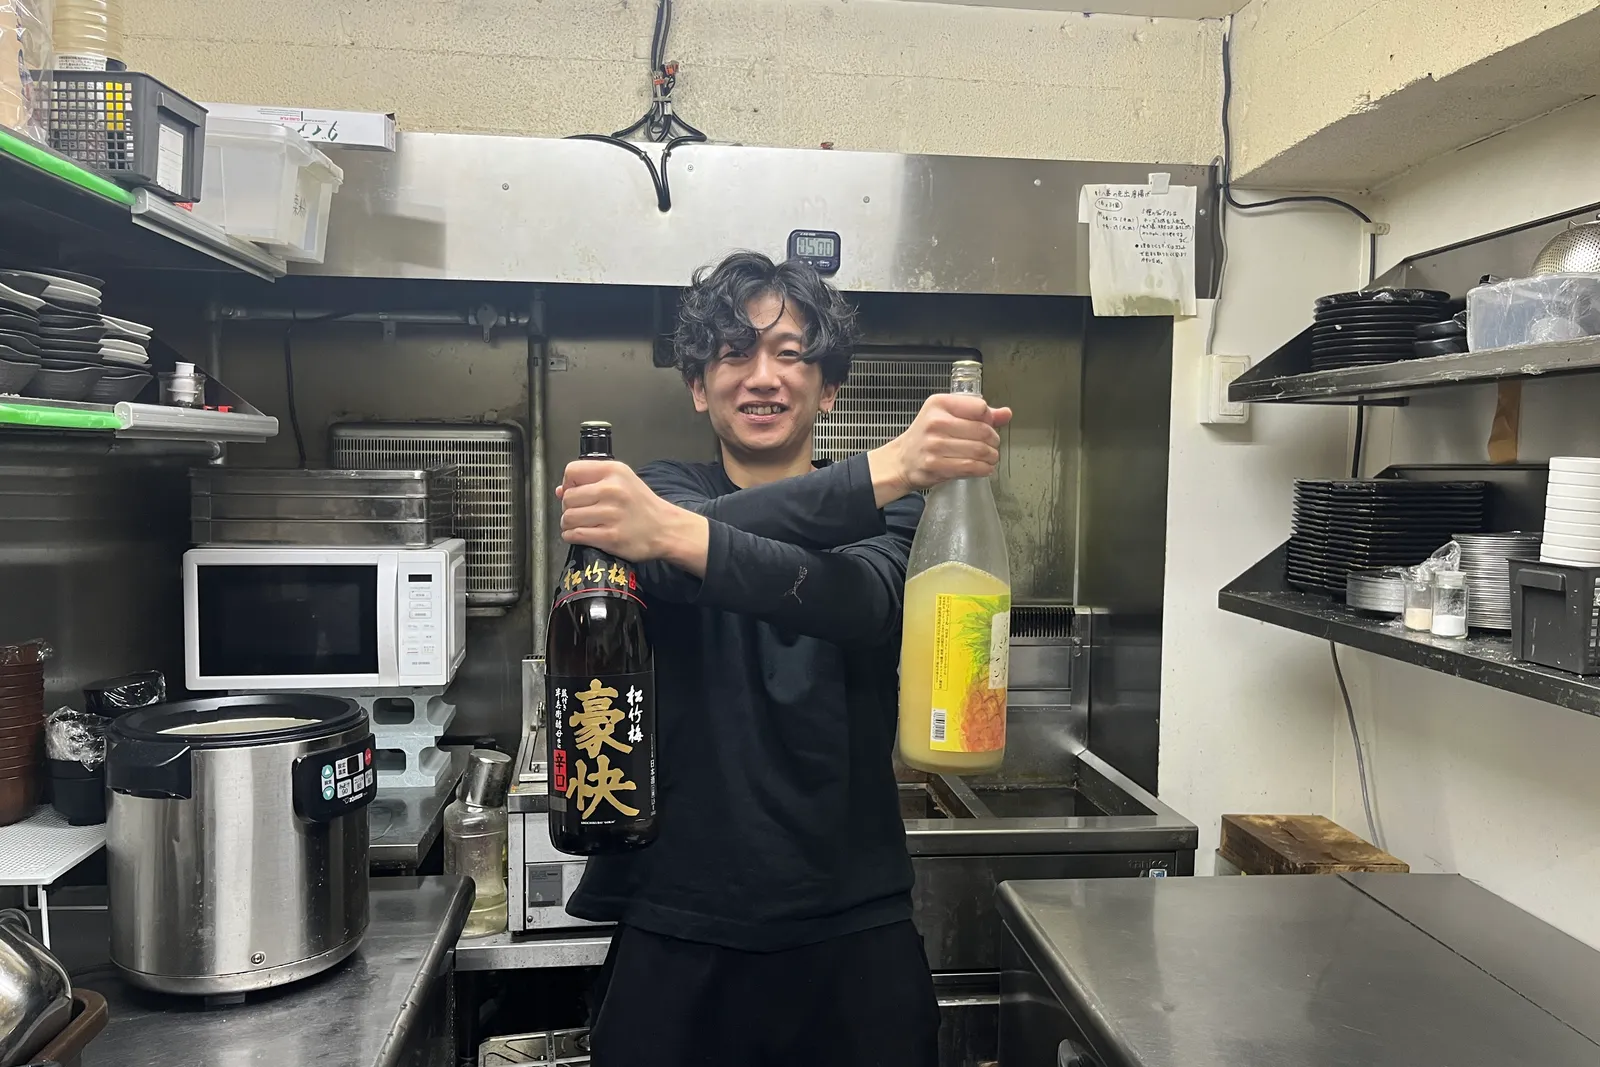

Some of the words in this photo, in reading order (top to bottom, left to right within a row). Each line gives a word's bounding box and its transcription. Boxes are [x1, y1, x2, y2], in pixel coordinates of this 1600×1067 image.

[564, 560, 628, 591] 松竹梅
[625, 684, 644, 744] 松竹梅
[554, 752, 566, 788] 辛口
[565, 678, 641, 820] 豪快
